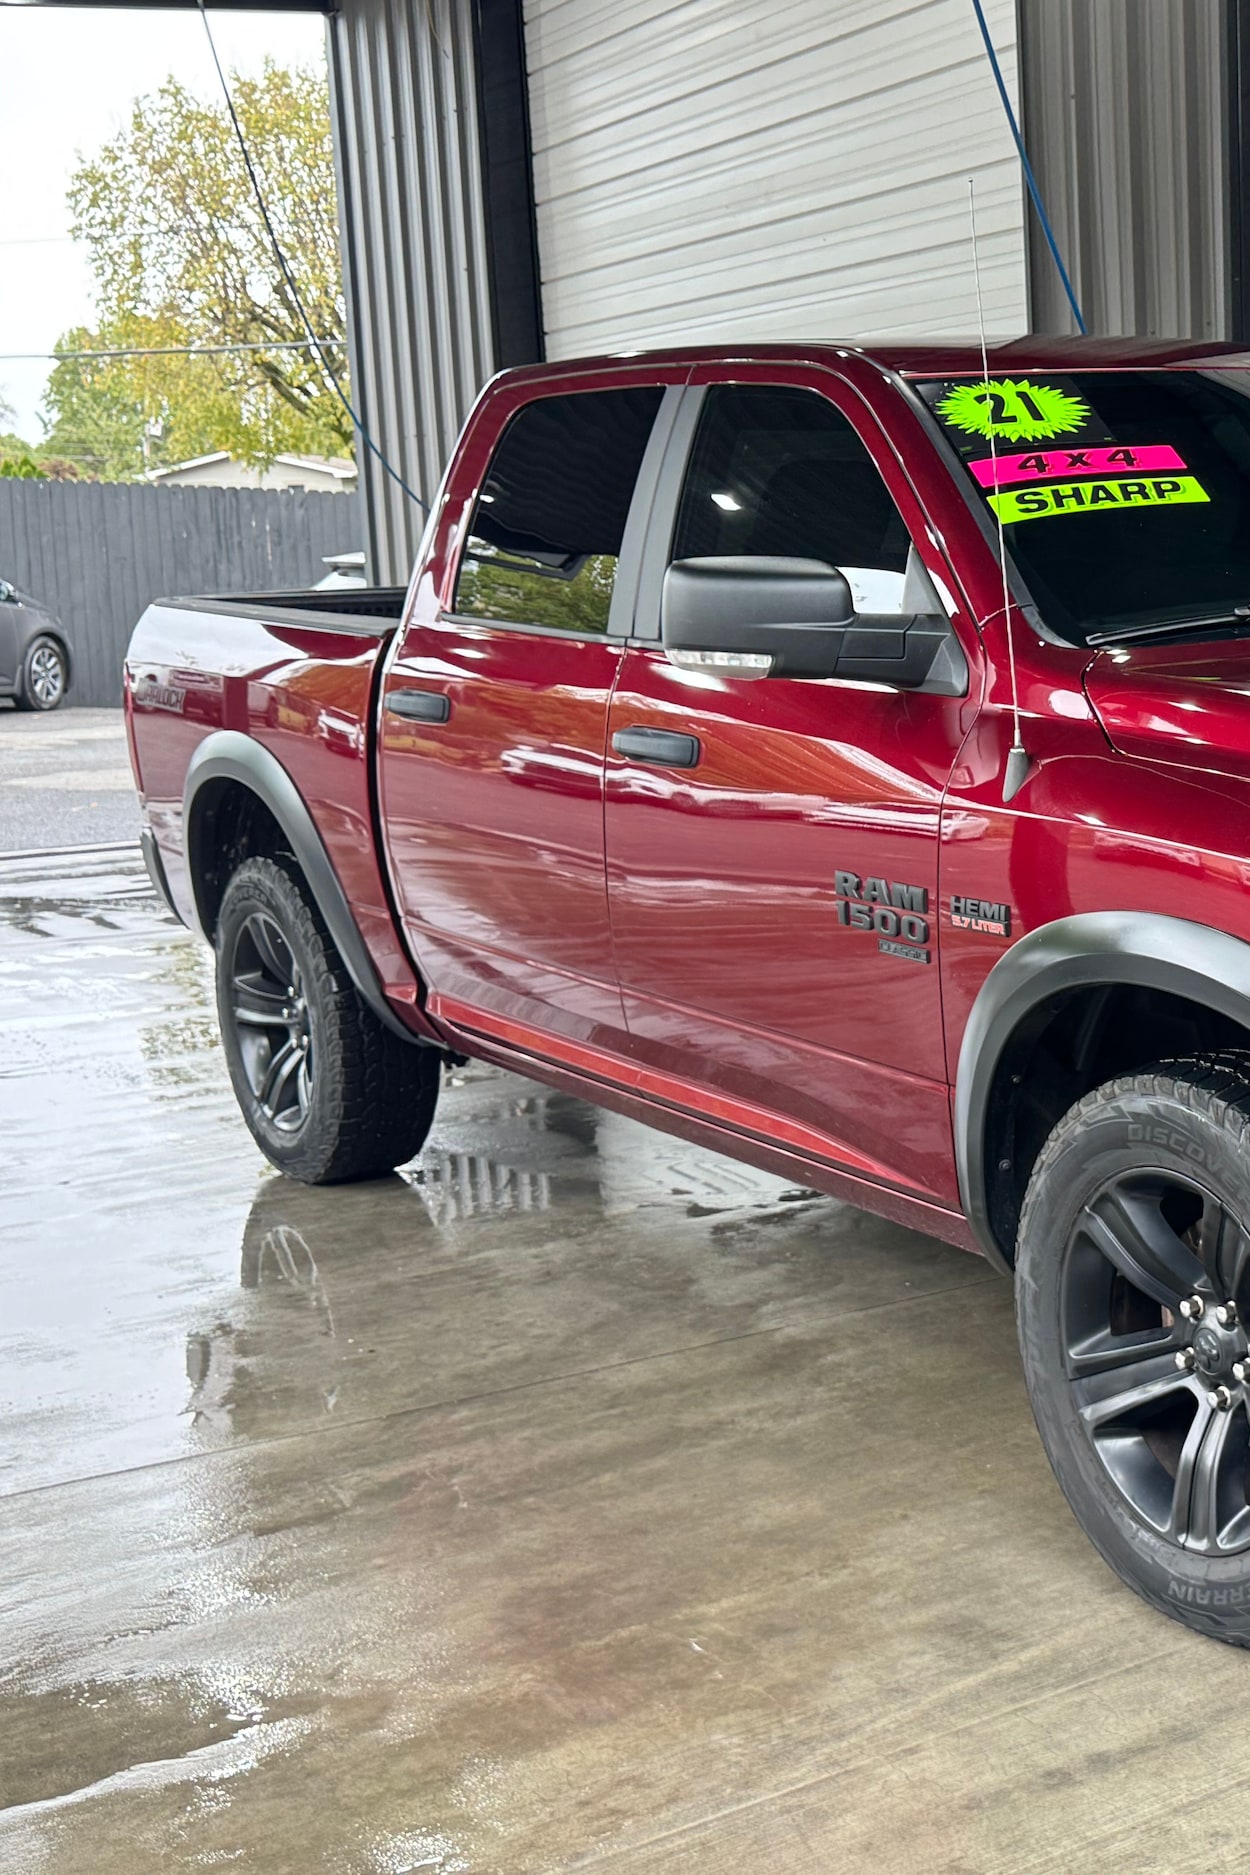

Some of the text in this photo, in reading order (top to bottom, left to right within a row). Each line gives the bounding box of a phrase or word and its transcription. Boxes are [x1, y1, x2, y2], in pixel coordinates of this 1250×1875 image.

[973, 391, 1046, 425] 21
[1015, 480, 1184, 514] SHARP
[834, 870, 929, 914] RAM
[951, 895, 1010, 921] HEMI
[836, 900, 929, 944] 1500
[952, 914, 1006, 935] 5.7 LITER
